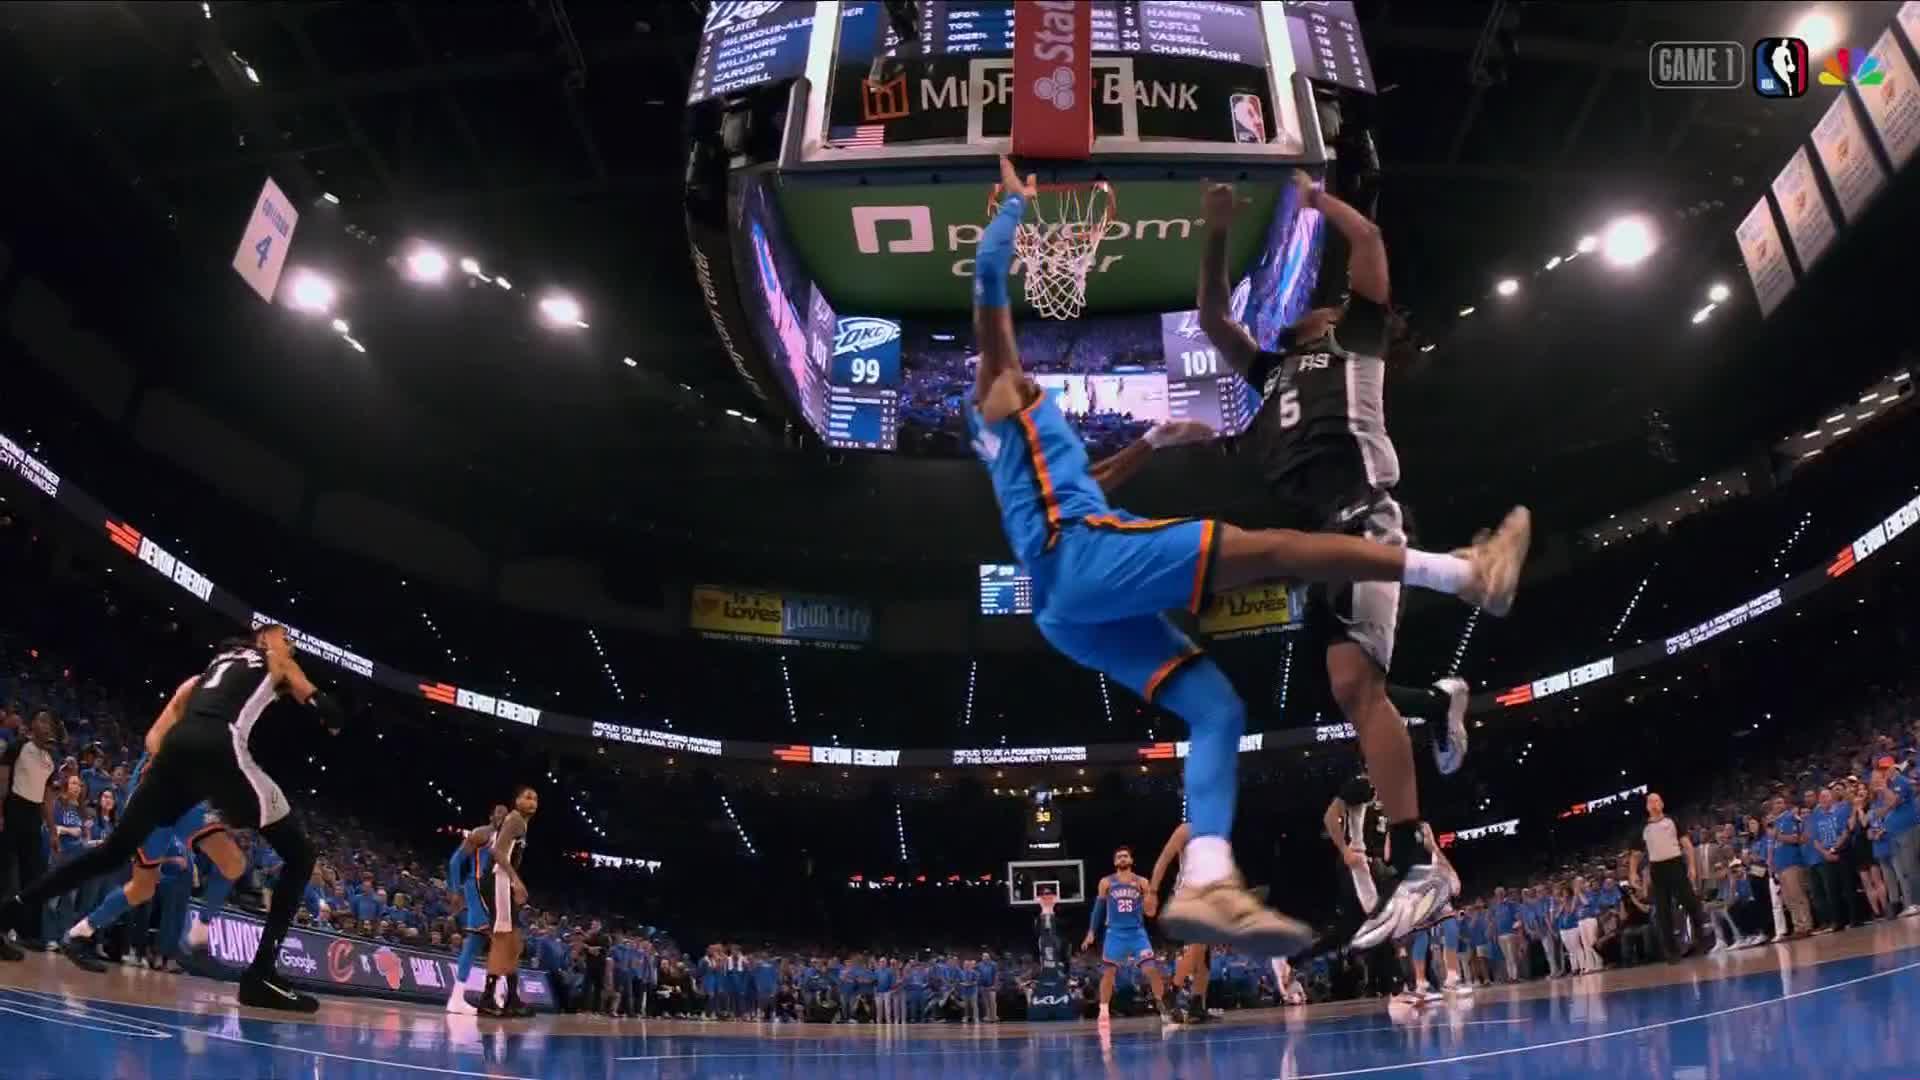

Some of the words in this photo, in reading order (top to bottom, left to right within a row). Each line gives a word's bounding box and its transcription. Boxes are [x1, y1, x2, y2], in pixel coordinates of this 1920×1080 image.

[1146, 9, 1204, 21] HARPER
[1148, 19, 1201, 33] CASTLE
[718, 34, 787, 60] HOLMGREN
[1150, 31, 1210, 47] VASSELL
[716, 47, 777, 71] WILLIAMS
[1150, 43, 1243, 63] CHAMPAGNIE
[711, 72, 773, 96] MITCHELL
[713, 61, 766, 83] CARUSO
[1102, 72, 1200, 113] BANK
[255, 235, 273, 269] 4
[850, 357, 880, 384] 99
[1180, 349, 1218, 377] 101
[1279, 388, 1301, 428] 5
[20, 462, 58, 498] THUNDER
[24, 454, 60, 487] PARTNER
[1852, 523, 1887, 563] DEVON
[139, 535, 176, 579] DEVON
[172, 560, 214, 603] ENERGY
[1730, 612, 1748, 627] CITY
[322, 650, 341, 665] CITY
[1531, 671, 1571, 700] DEVON
[1569, 656, 1615, 688] ENERGY
[456, 687, 496, 716] DEVON
[593, 721, 620, 734] PROUD
[620, 725, 632, 735] TO
[642, 729, 650, 738] A
[605, 731, 621, 741] THE
[621, 733, 667, 748] OKLAHOMA
[666, 740, 687, 752] CITY
[686, 743, 722, 756] THUNDER
[1028, 754, 1050, 763] CITY
[1117, 899, 1133, 913] 25
[279, 947, 318, 974] Google
